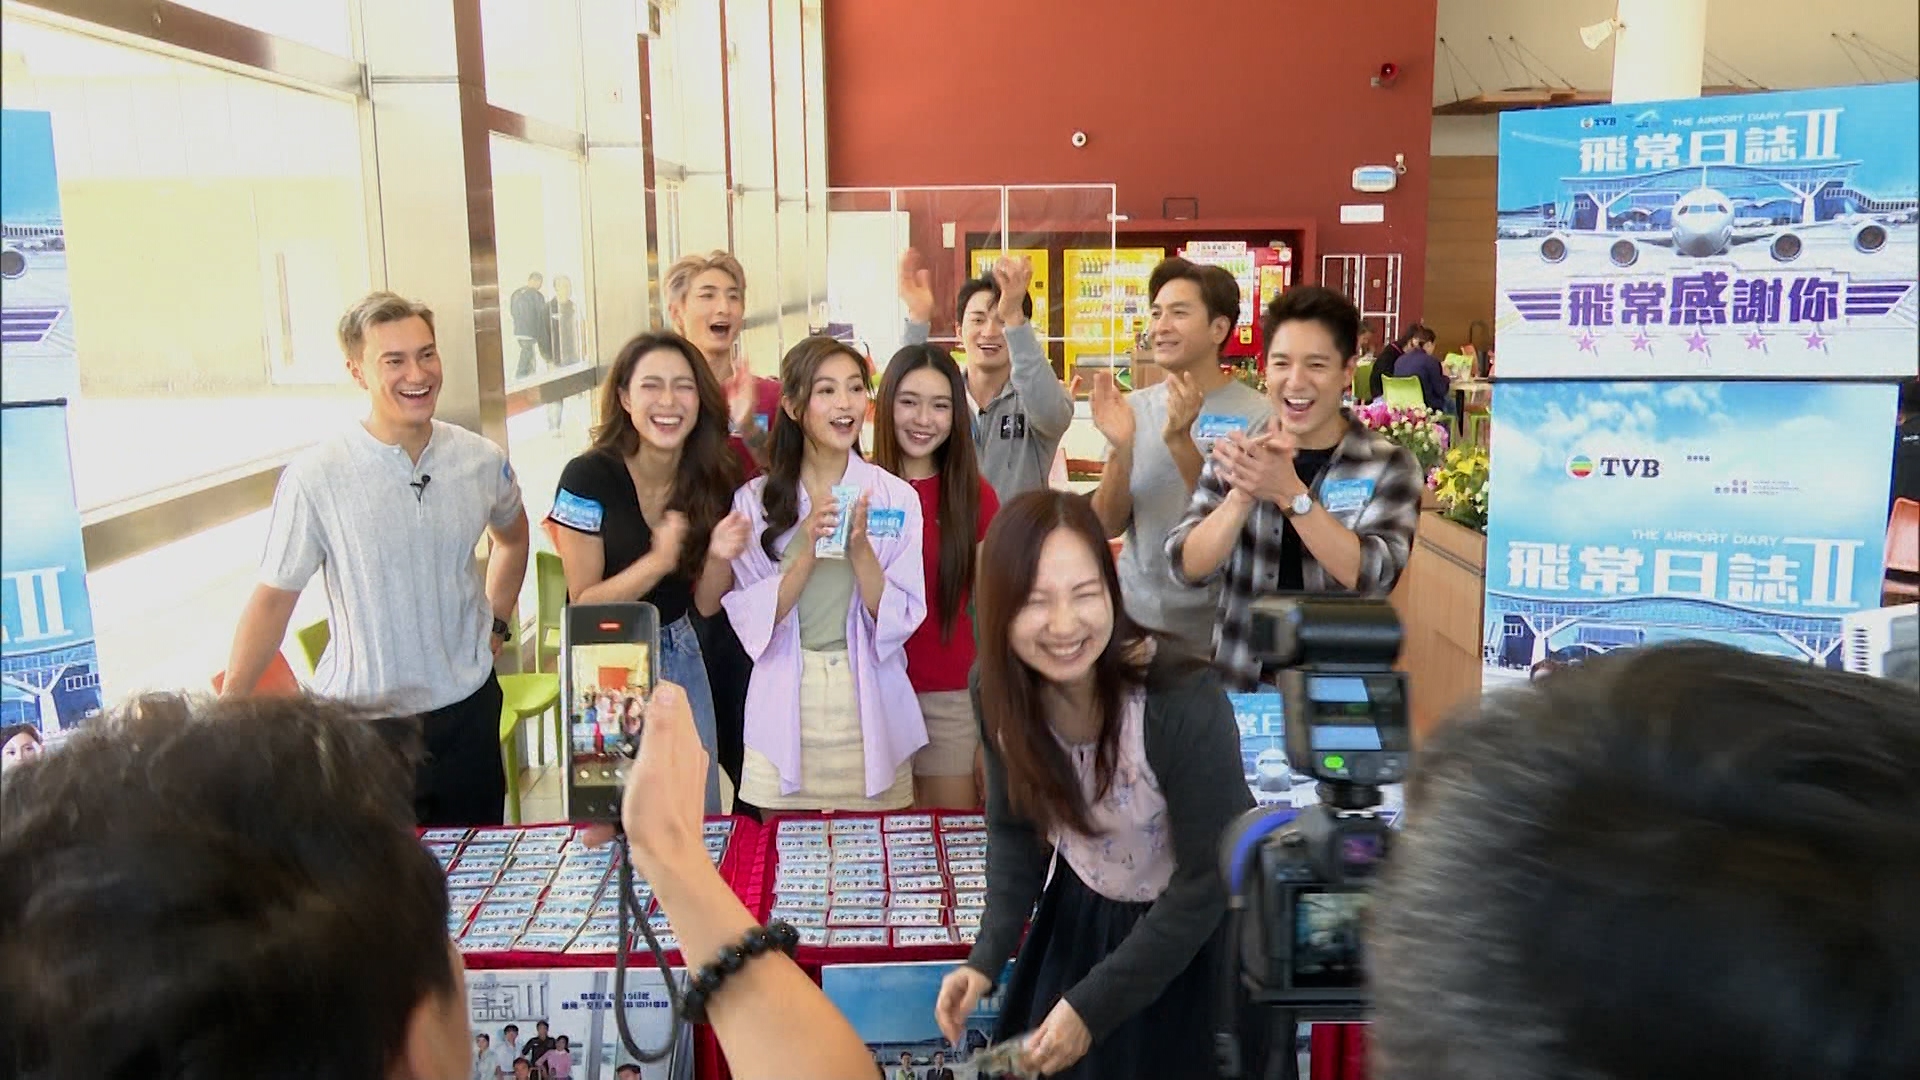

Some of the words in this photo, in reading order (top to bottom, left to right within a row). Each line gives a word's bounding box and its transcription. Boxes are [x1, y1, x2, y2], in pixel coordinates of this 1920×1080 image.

[1595, 117, 1617, 127] TVB
[1672, 118, 1693, 127] THE
[1697, 114, 1744, 126] AIRPORT
[1748, 112, 1782, 122] DIARY
[1568, 271, 1839, 326] 飛常感謝你
[1600, 457, 1660, 478] TVB
[1631, 529, 1660, 541] THE
[1664, 530, 1728, 545] AIRPORT
[1733, 534, 1779, 547] DIARY
